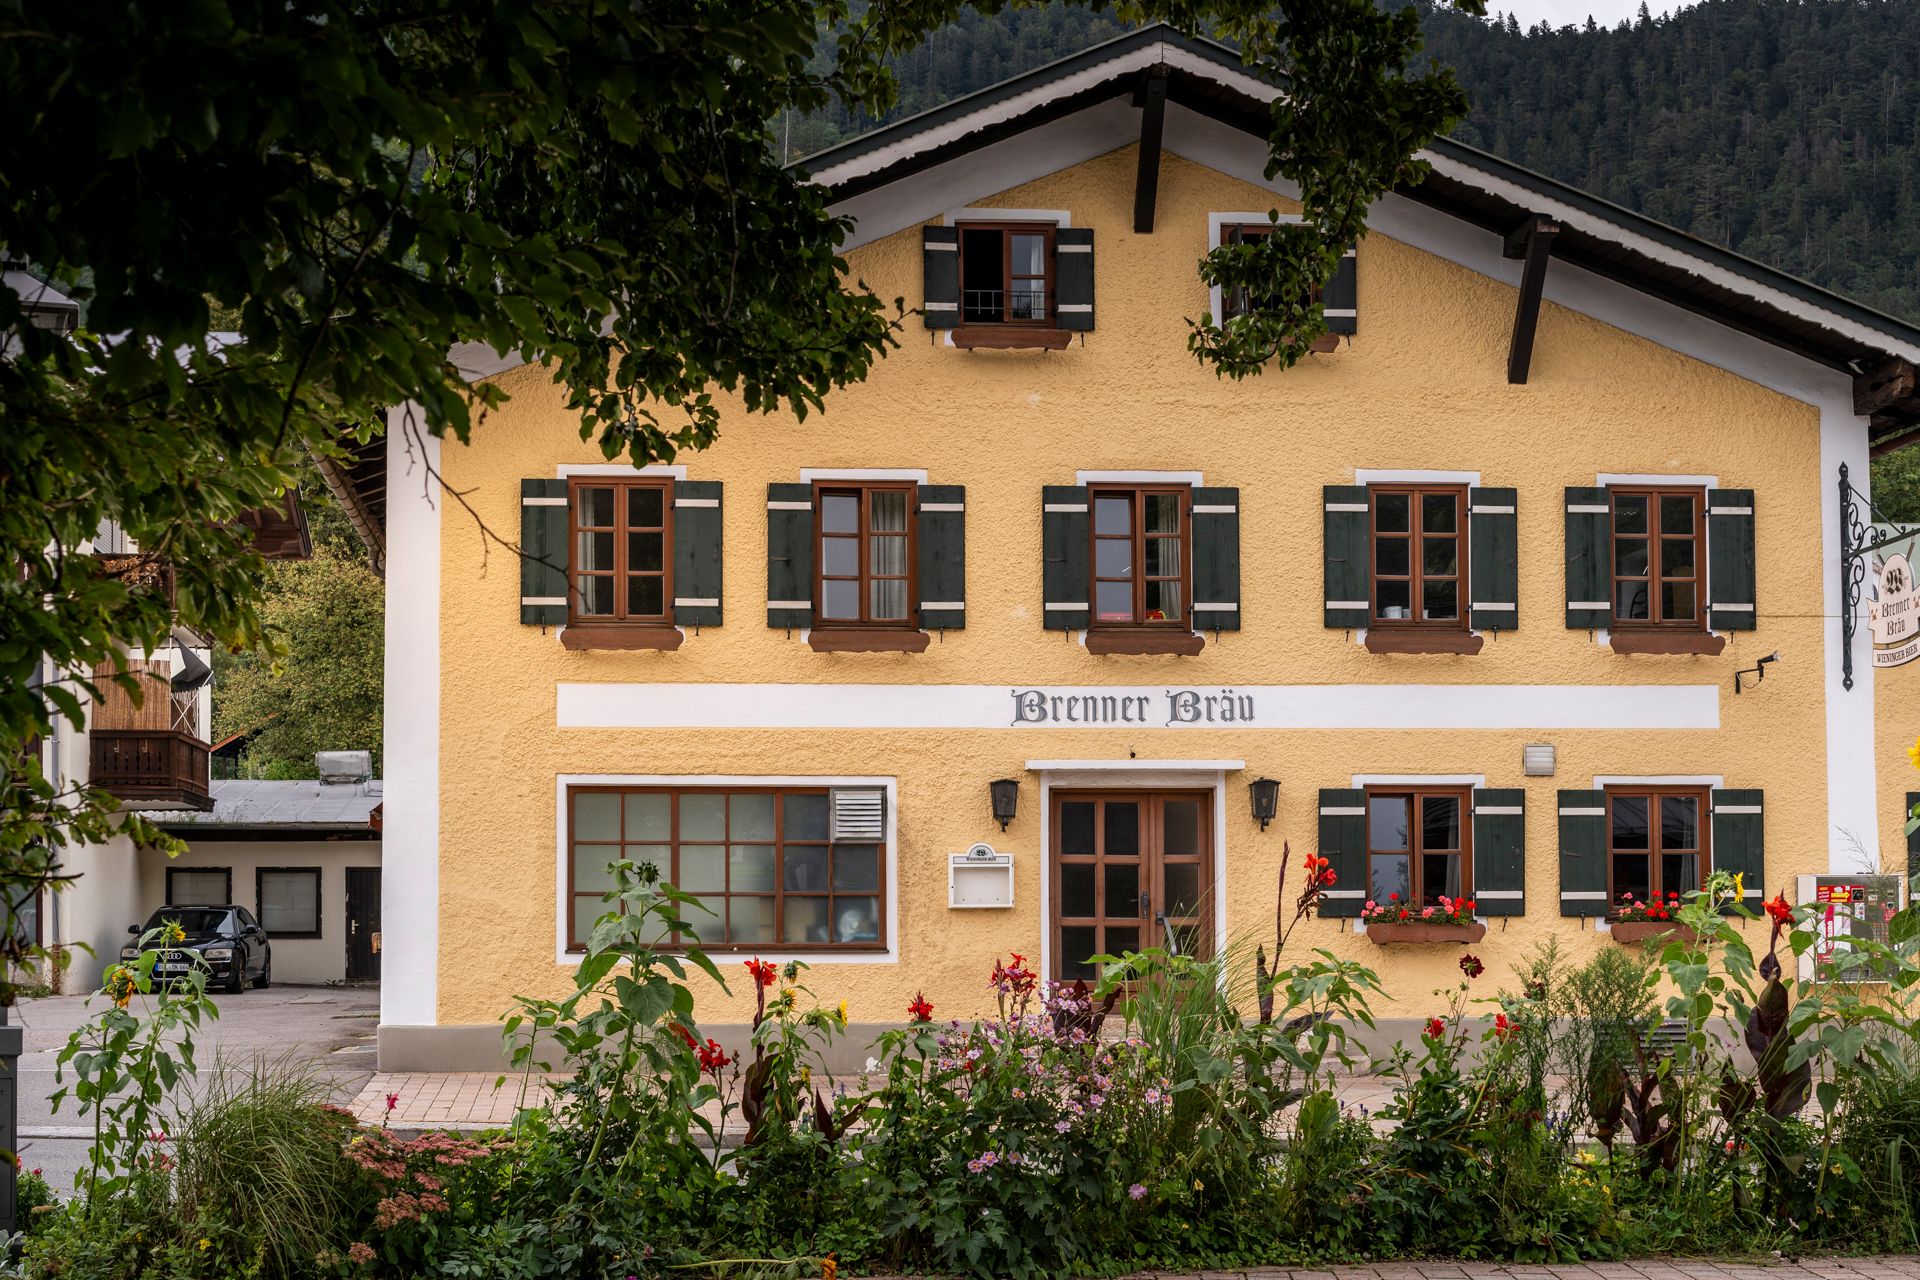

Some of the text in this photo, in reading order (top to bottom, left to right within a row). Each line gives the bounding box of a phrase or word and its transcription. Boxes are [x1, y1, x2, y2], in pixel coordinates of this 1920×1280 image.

[1881, 597, 1910, 618] Brenner
[1887, 618, 1906, 636] Bräu
[1876, 643, 1918, 664] WIENINGER BIER
[1010, 689, 1255, 727] Brenner Bräu
